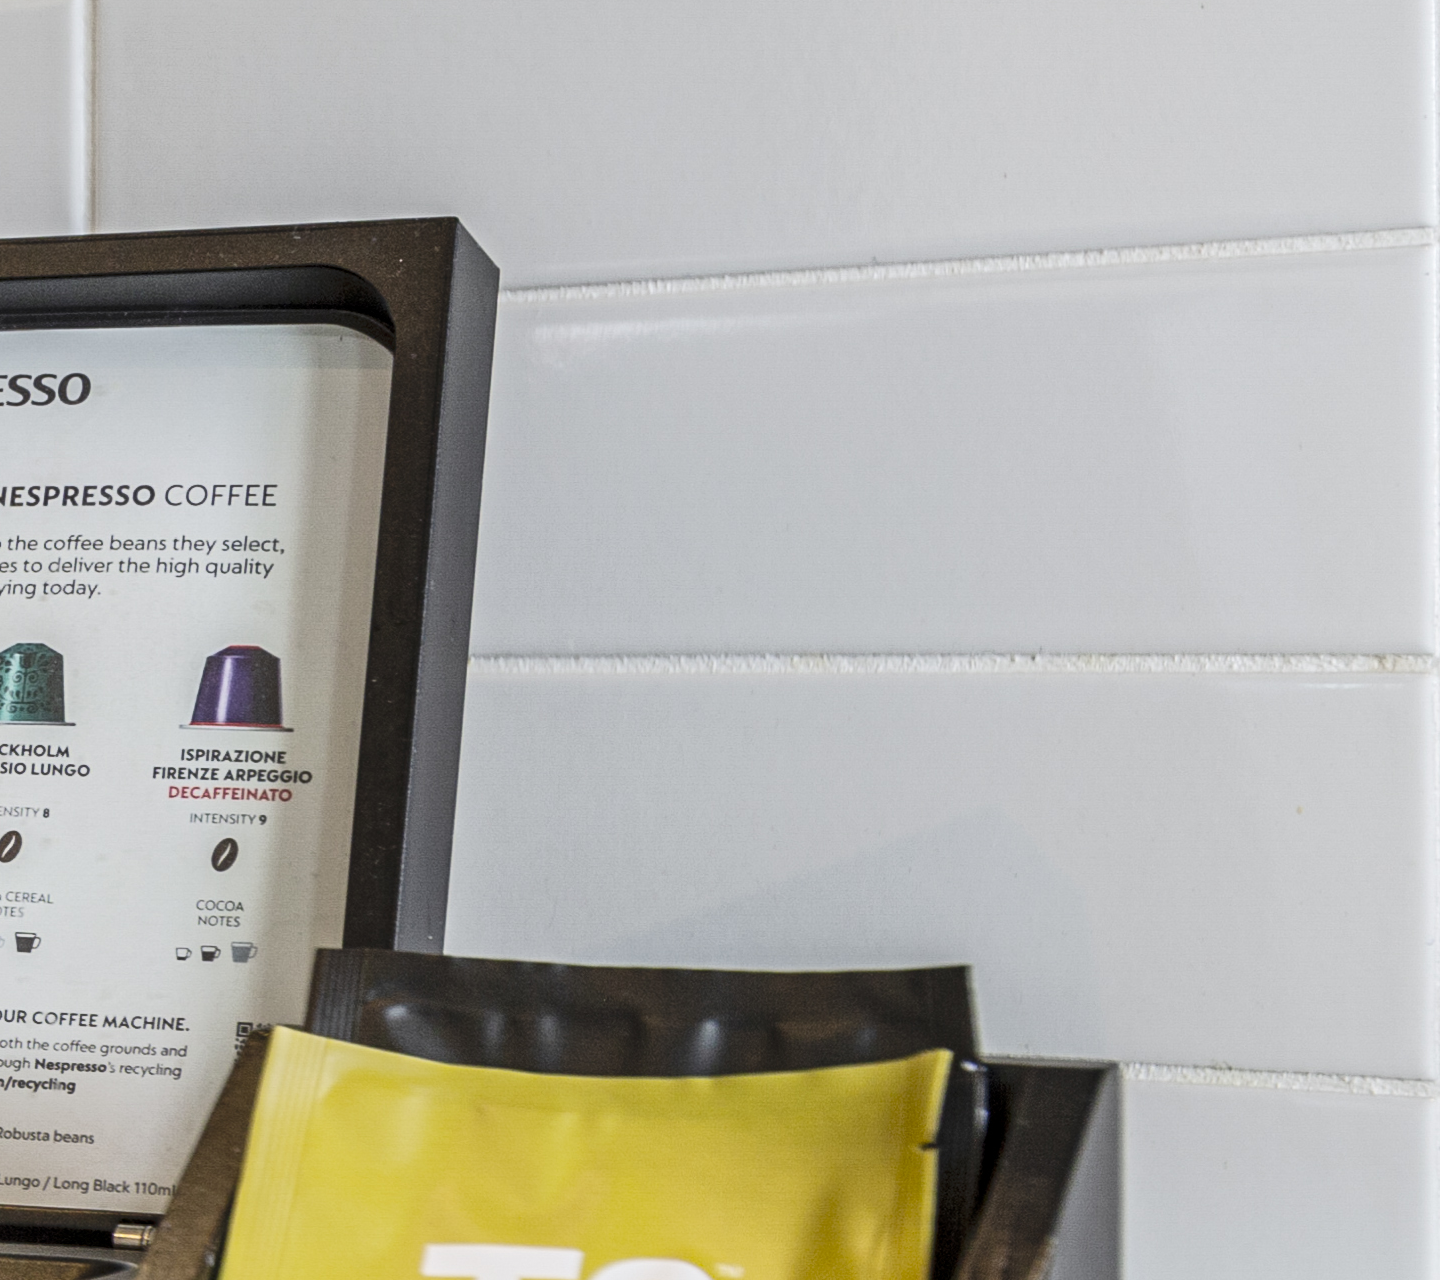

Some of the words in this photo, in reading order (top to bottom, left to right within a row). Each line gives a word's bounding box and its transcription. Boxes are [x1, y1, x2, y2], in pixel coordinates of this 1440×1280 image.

[164, 484, 277, 506] COFFEE
[7, 536, 38, 551] the
[43, 535, 103, 550] coffee
[109, 535, 166, 551] beans
[173, 534, 216, 555] they
[221, 535, 284, 554] select,
[23, 559, 42, 573] to
[48, 559, 113, 574] deliver
[118, 558, 150, 573] the
[156, 557, 199, 578] high
[205, 558, 274, 579] quality
[43, 579, 100, 599] today.
[180, 748, 286, 764] ISPIRAZIONE
[30, 763, 90, 777] LUNGO
[152, 766, 219, 780] FIRENZE
[223, 768, 312, 784] ARPEGGIO
[168, 785, 292, 802] DECAFFEINATO
[42, 807, 50, 818] 8
[190, 812, 256, 824] INTENSITY
[258, 814, 267, 825] 9
[5, 890, 53, 904] CEREAL
[196, 899, 244, 911] COCOA
[197, 915, 240, 927] NOTES
[32, 1011, 98, 1027] COFFEE
[102, 1015, 189, 1031] MACHINE.
[27, 1038, 49, 1050] the
[53, 1039, 96, 1053] coffee
[99, 1044, 156, 1057] grounds
[160, 1045, 187, 1057] and
[119, 1063, 182, 1080] recycling
[53, 1129, 94, 1144] beans
[53, 1176, 89, 1194] Long
[93, 1178, 130, 1193] Black
